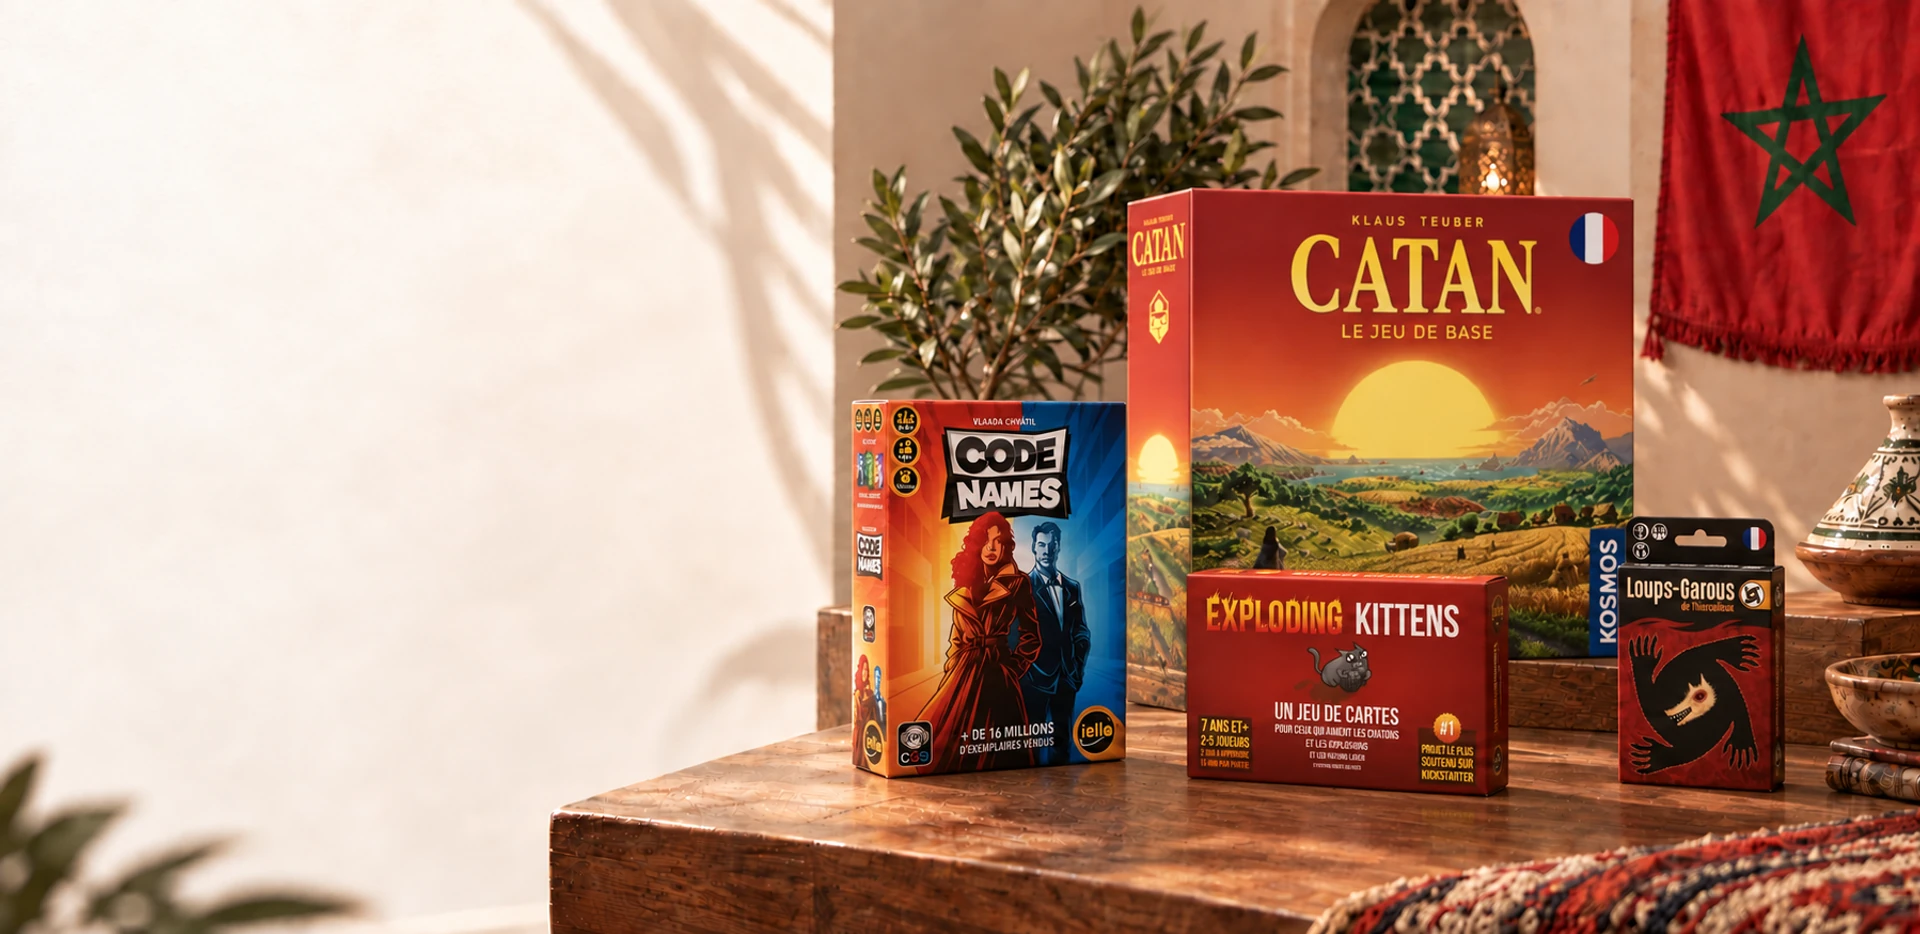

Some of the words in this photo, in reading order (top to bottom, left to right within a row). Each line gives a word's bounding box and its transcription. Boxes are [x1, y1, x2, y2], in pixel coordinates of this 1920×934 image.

[1352, 215, 1406, 226] KLAUS
[1420, 216, 1484, 228] TEUBER
[1132, 222, 1186, 267] CATAN
[1291, 234, 1538, 314] CATAN
[1342, 324, 1363, 338] LE
[1370, 324, 1405, 339] JEU
[1414, 325, 1438, 339] DE
[1446, 325, 1493, 339] BASE
[955, 436, 1056, 474] CODE
[957, 477, 1062, 510] NAMES
[858, 537, 880, 556] CODE
[1599, 539, 1618, 643] KOSMOS
[1627, 576, 1735, 605] Loups-Garous
[1206, 590, 1343, 635] EXPLODING
[1356, 602, 1459, 638] KITTENS
[1274, 701, 1293, 720] UN
[1297, 703, 1320, 721] JEU
[1324, 704, 1342, 722] DE
[1345, 705, 1399, 726] CARTES
[972, 728, 986, 741] DE
[989, 727, 1002, 740] 16
[1004, 721, 1054, 738] MILLIONS
[1081, 721, 1113, 738] iello
[1201, 718, 1207, 732] 7
[1209, 719, 1229, 733] ANS
[1274, 723, 1293, 734] POUR
[1353, 728, 1366, 738] LES
[1440, 720, 1454, 736] #1
[1023, 736, 1054, 748] VENDUS
[1200, 734, 1214, 746] 2-5
[1305, 739, 1314, 748] ET
[1447, 745, 1455, 755] LE
[1457, 758, 1474, 769] SUR
